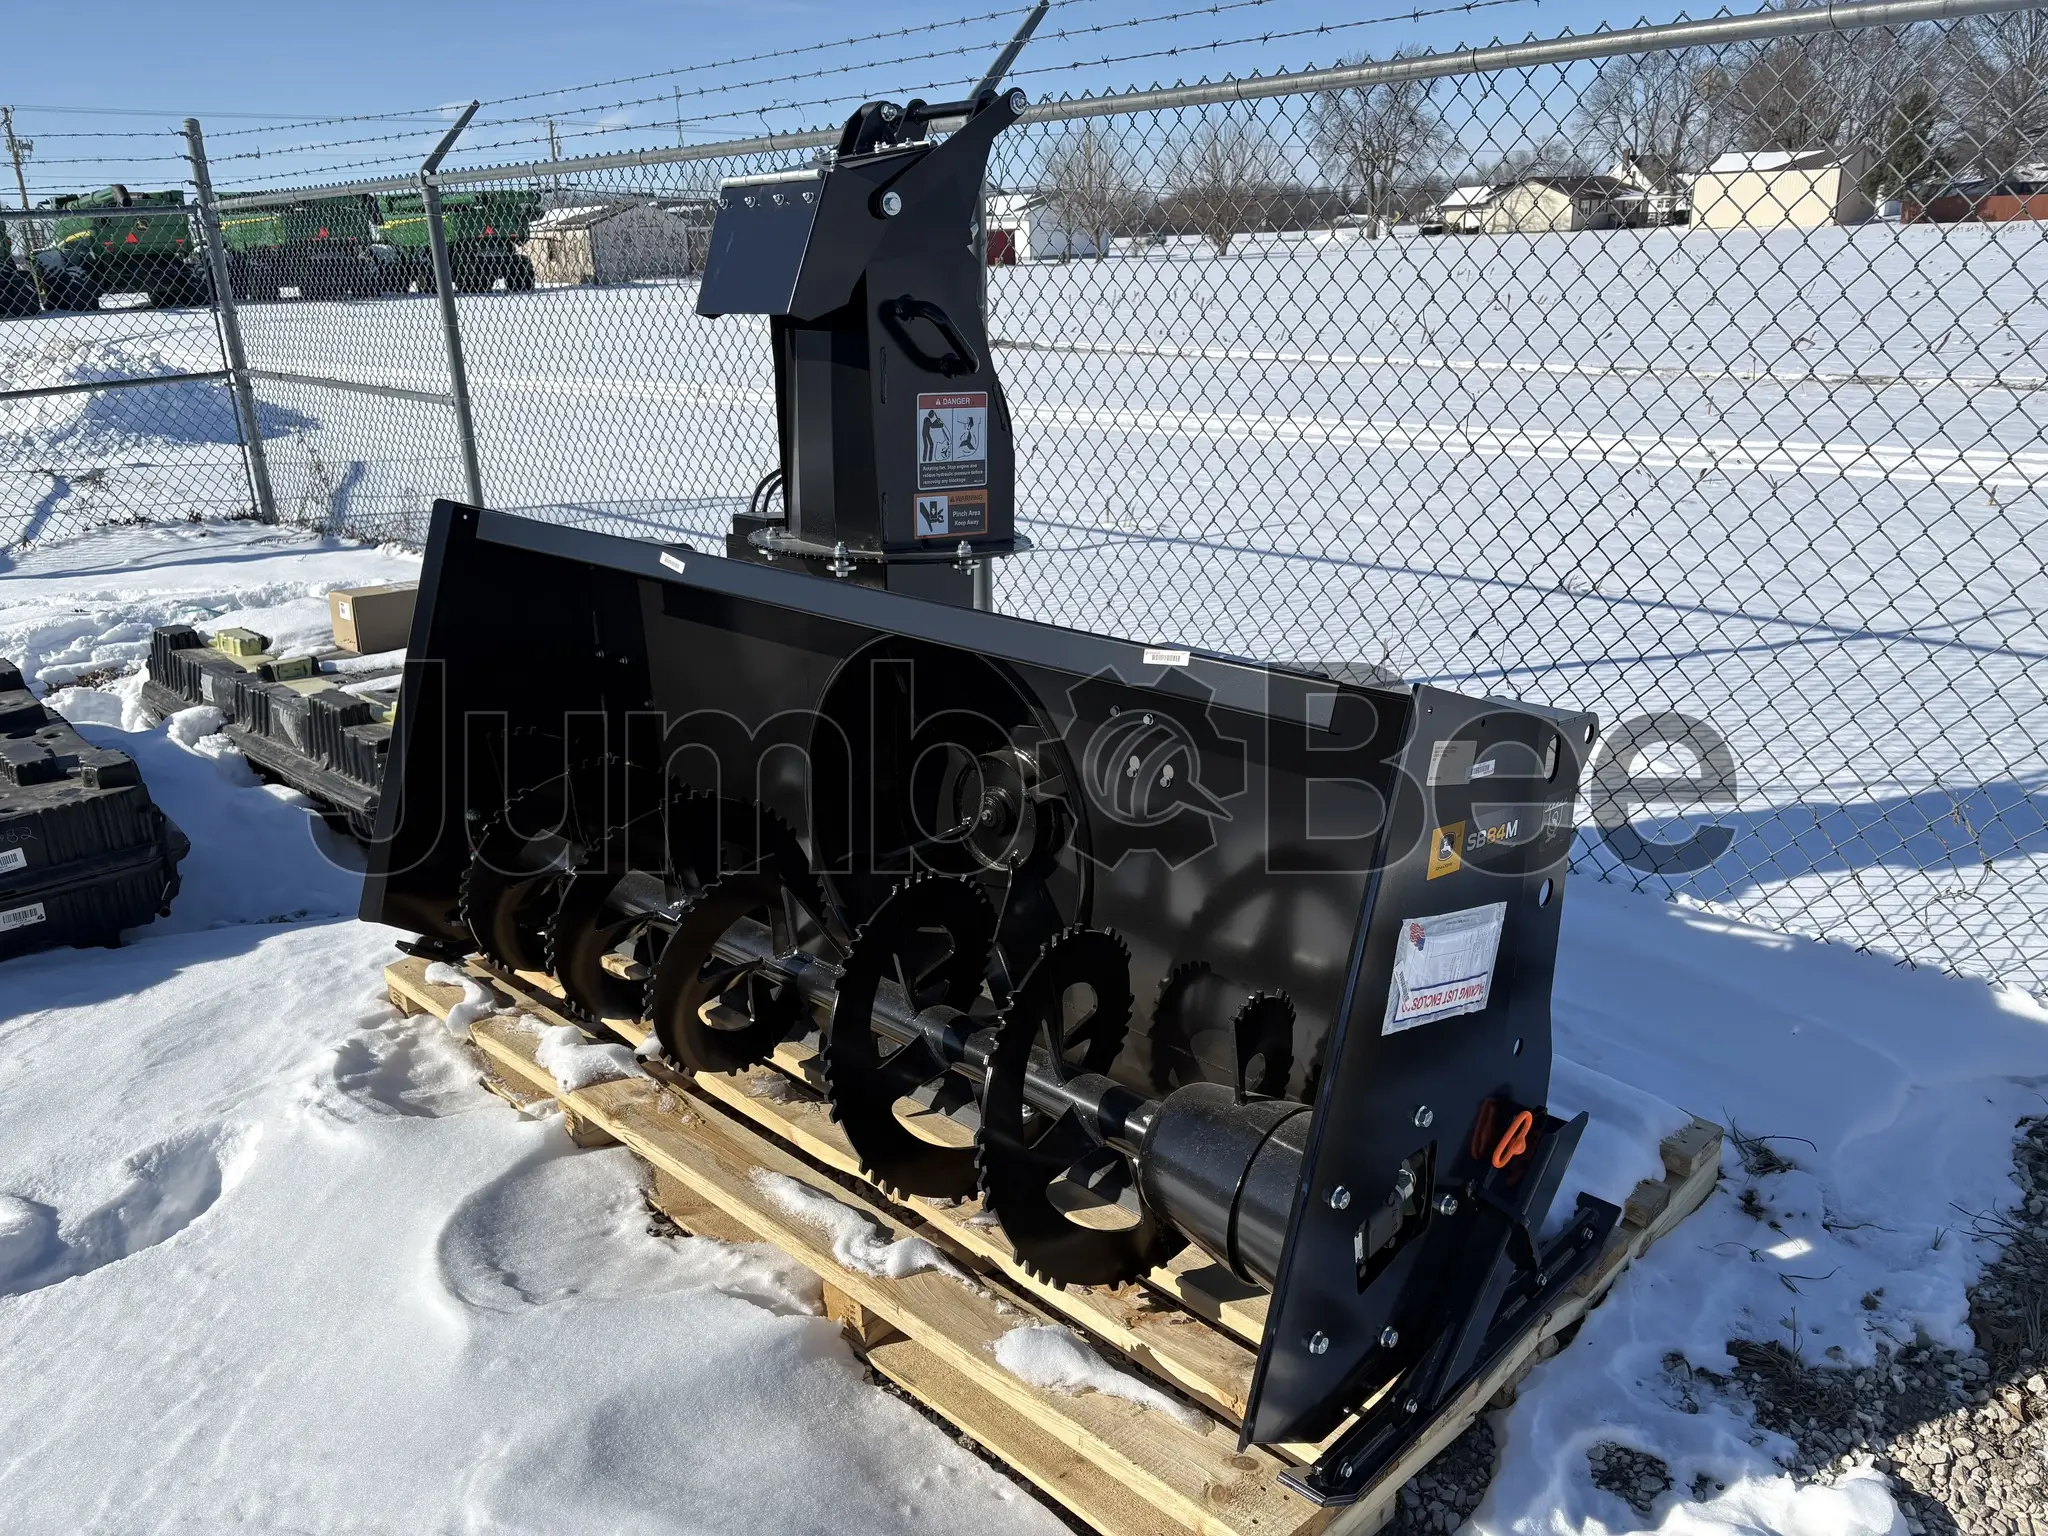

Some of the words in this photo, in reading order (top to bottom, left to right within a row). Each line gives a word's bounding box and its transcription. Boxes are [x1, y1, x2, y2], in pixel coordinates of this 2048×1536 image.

[943, 397, 970, 405] DANGER
[955, 494, 983, 502] WARNING
[1466, 819, 1519, 851] SB84M
[1402, 992, 1442, 1012] ENCLOS
[1442, 988, 1459, 1004] LIST
